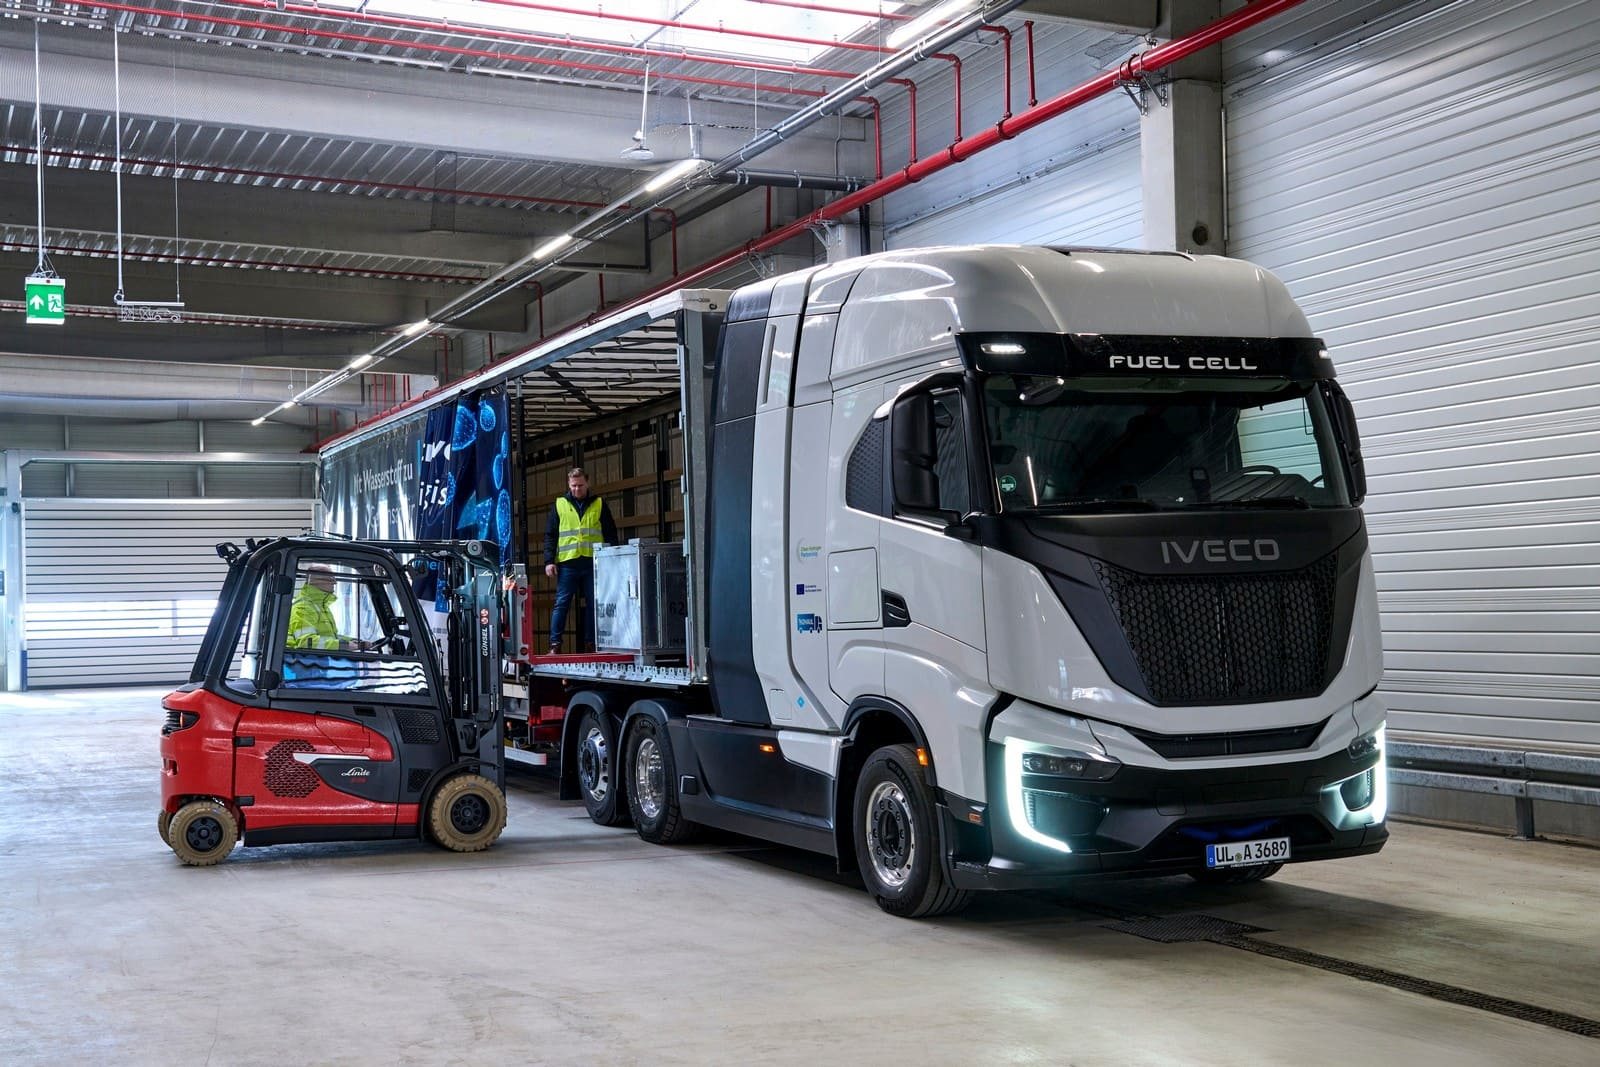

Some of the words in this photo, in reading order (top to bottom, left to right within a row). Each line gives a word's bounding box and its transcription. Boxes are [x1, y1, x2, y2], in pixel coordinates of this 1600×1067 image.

[1109, 355, 1180, 369] FUEL
[1188, 356, 1257, 370] CELL
[403, 463, 413, 481] zu
[1160, 539, 1280, 564] IVECO
[341, 767, 370, 777] Linde
[1216, 846, 1234, 863] UL
[1243, 844, 1252, 860] A
[1254, 840, 1287, 859] 3689
